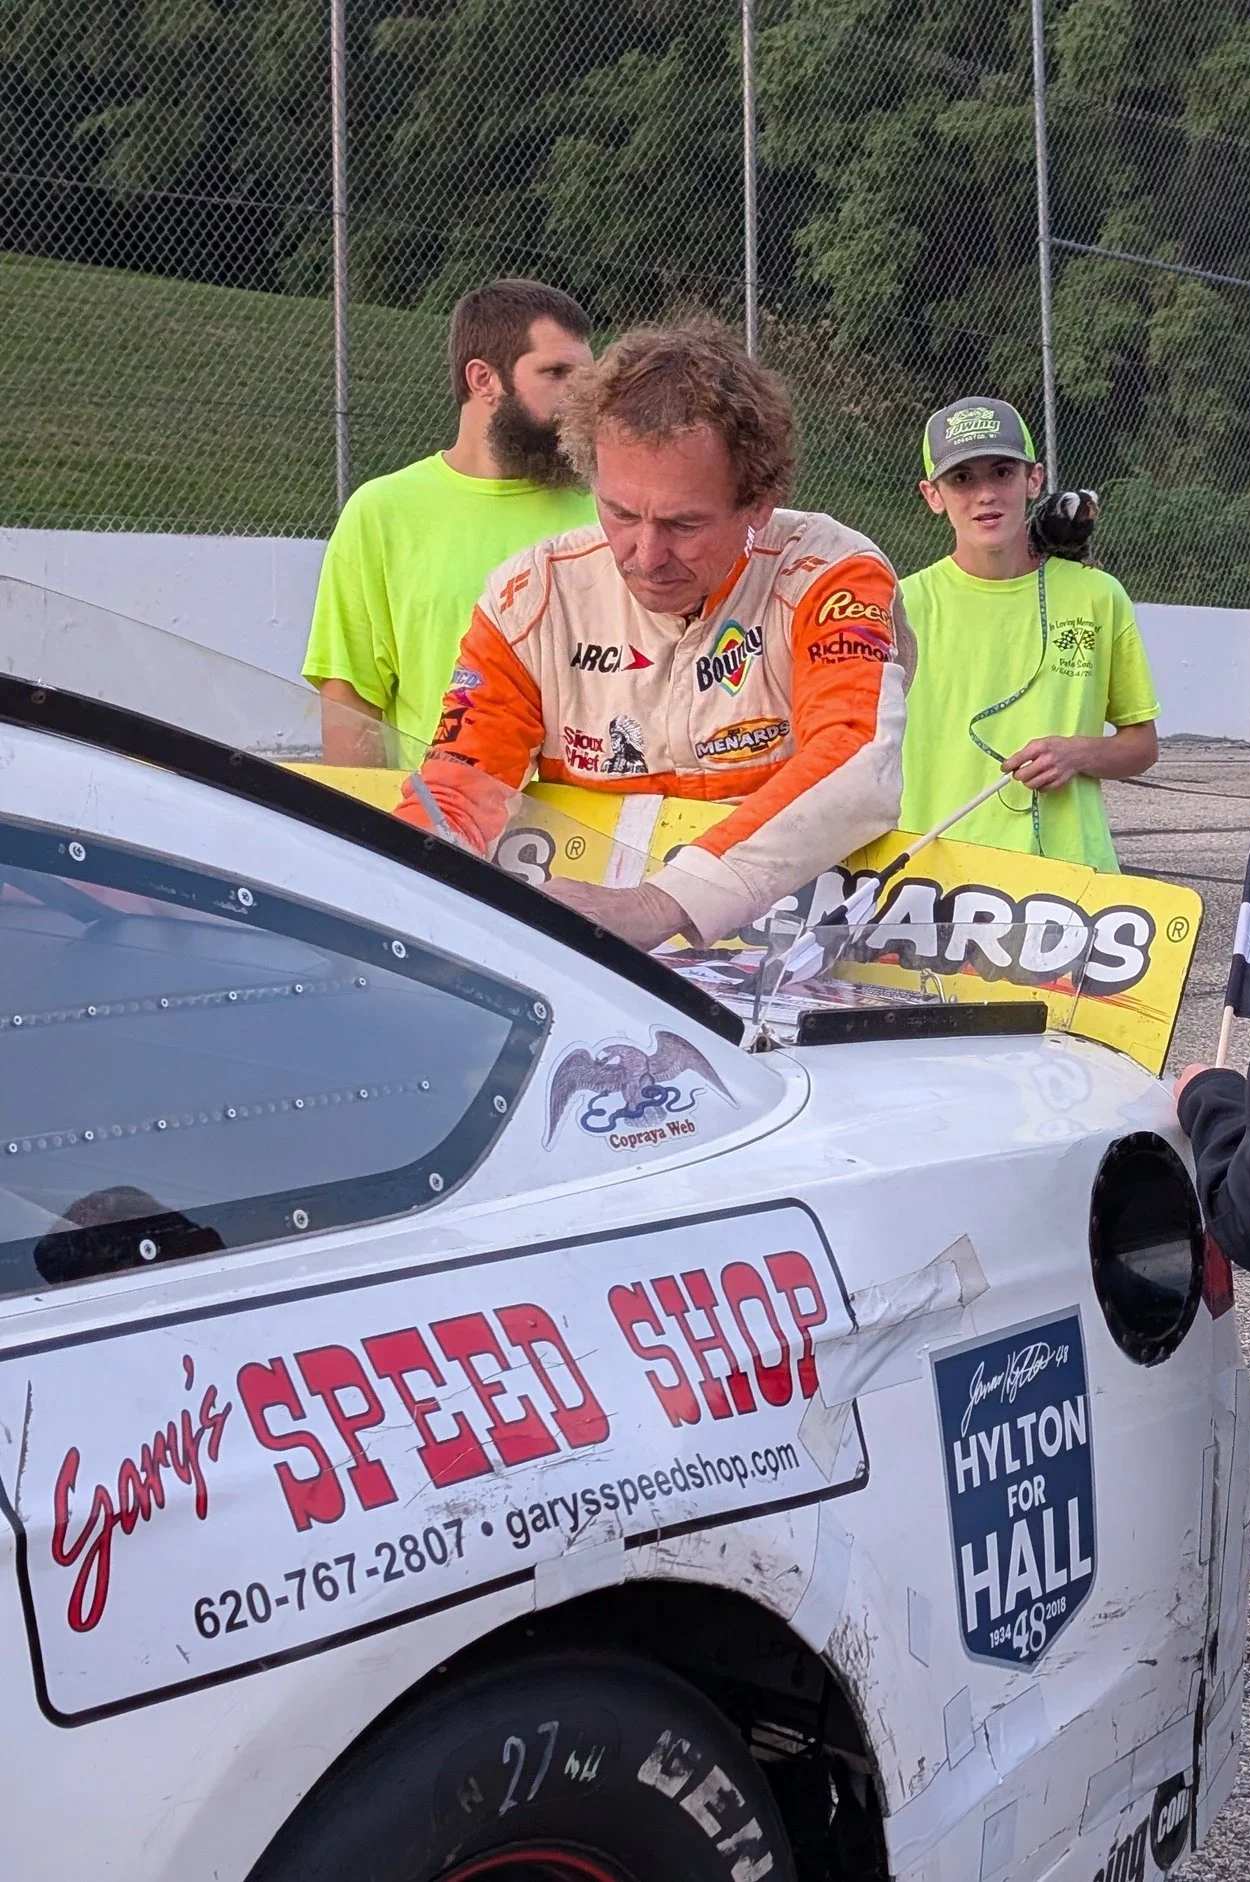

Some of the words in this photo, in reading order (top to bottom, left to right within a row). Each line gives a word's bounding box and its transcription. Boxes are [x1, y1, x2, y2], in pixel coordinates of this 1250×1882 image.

[563, 725, 604, 753] Sioux
[565, 744, 600, 773] Chief
[695, 719, 791, 759] MENARDS
[609, 1127, 667, 1149] Copraya
[665, 1118, 696, 1136] Web
[1055, 1344, 1069, 1368] 48
[52, 1354, 232, 1633] Gary's
[236, 1301, 611, 1533] SPEED
[607, 1250, 828, 1429] SHOP
[953, 1395, 1088, 1494] HYLTON
[1006, 1474, 1047, 1518] FOR
[193, 1518, 466, 1640] 620-767-2807
[505, 1440, 801, 1549] garysspeedshop.com
[960, 1496, 1092, 1633] HALL
[989, 1621, 1012, 1650] 1934
[1011, 1601, 1047, 1660] 48
[1045, 1595, 1067, 1620] 2018
